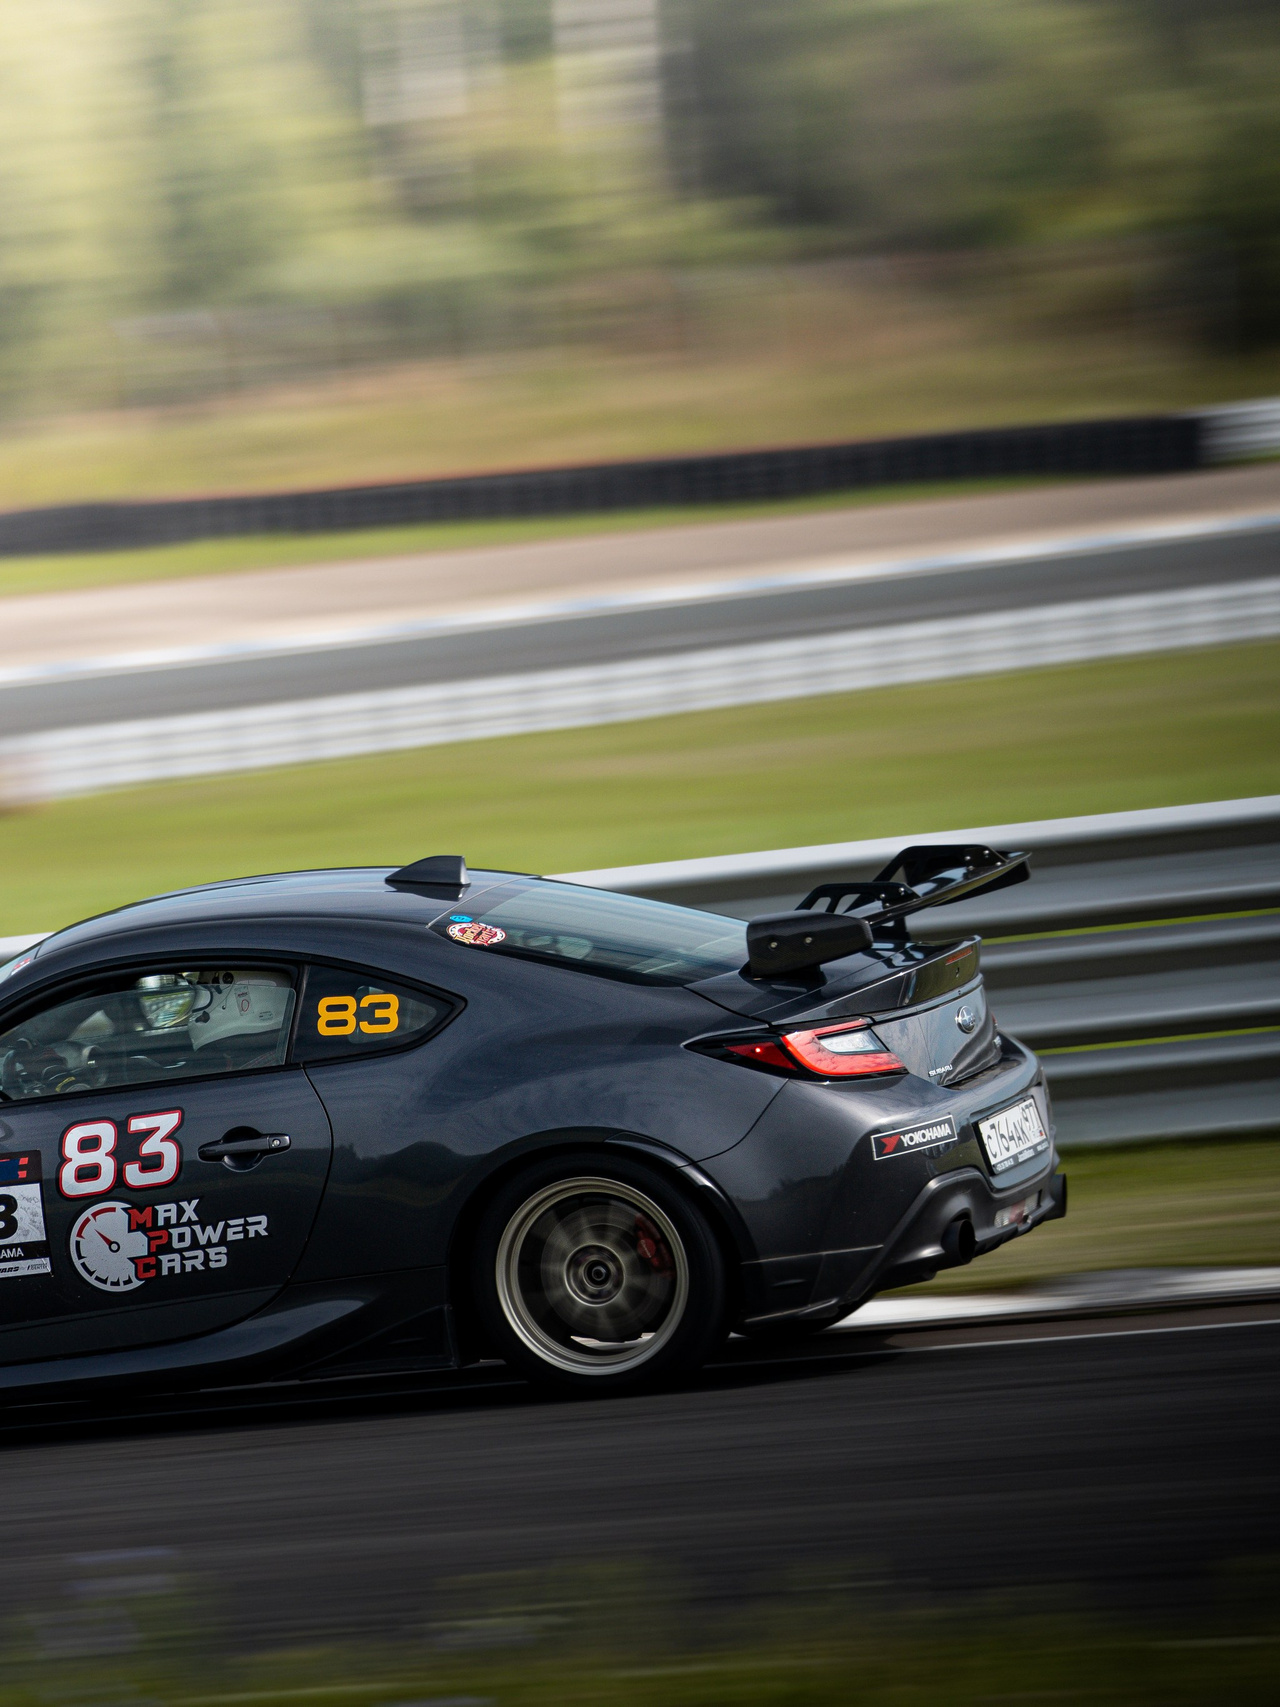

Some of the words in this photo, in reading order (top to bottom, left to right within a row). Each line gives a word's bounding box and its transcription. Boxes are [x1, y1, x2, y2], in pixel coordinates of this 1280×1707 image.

[317, 993, 399, 1036] 83
[928, 1063, 953, 1077] SUBARU
[900, 1123, 952, 1147] YOKOHAMA
[59, 1110, 182, 1198] 83
[128, 1199, 200, 1230] MAX
[147, 1215, 268, 1252] POWER
[134, 1246, 228, 1279] CARS
